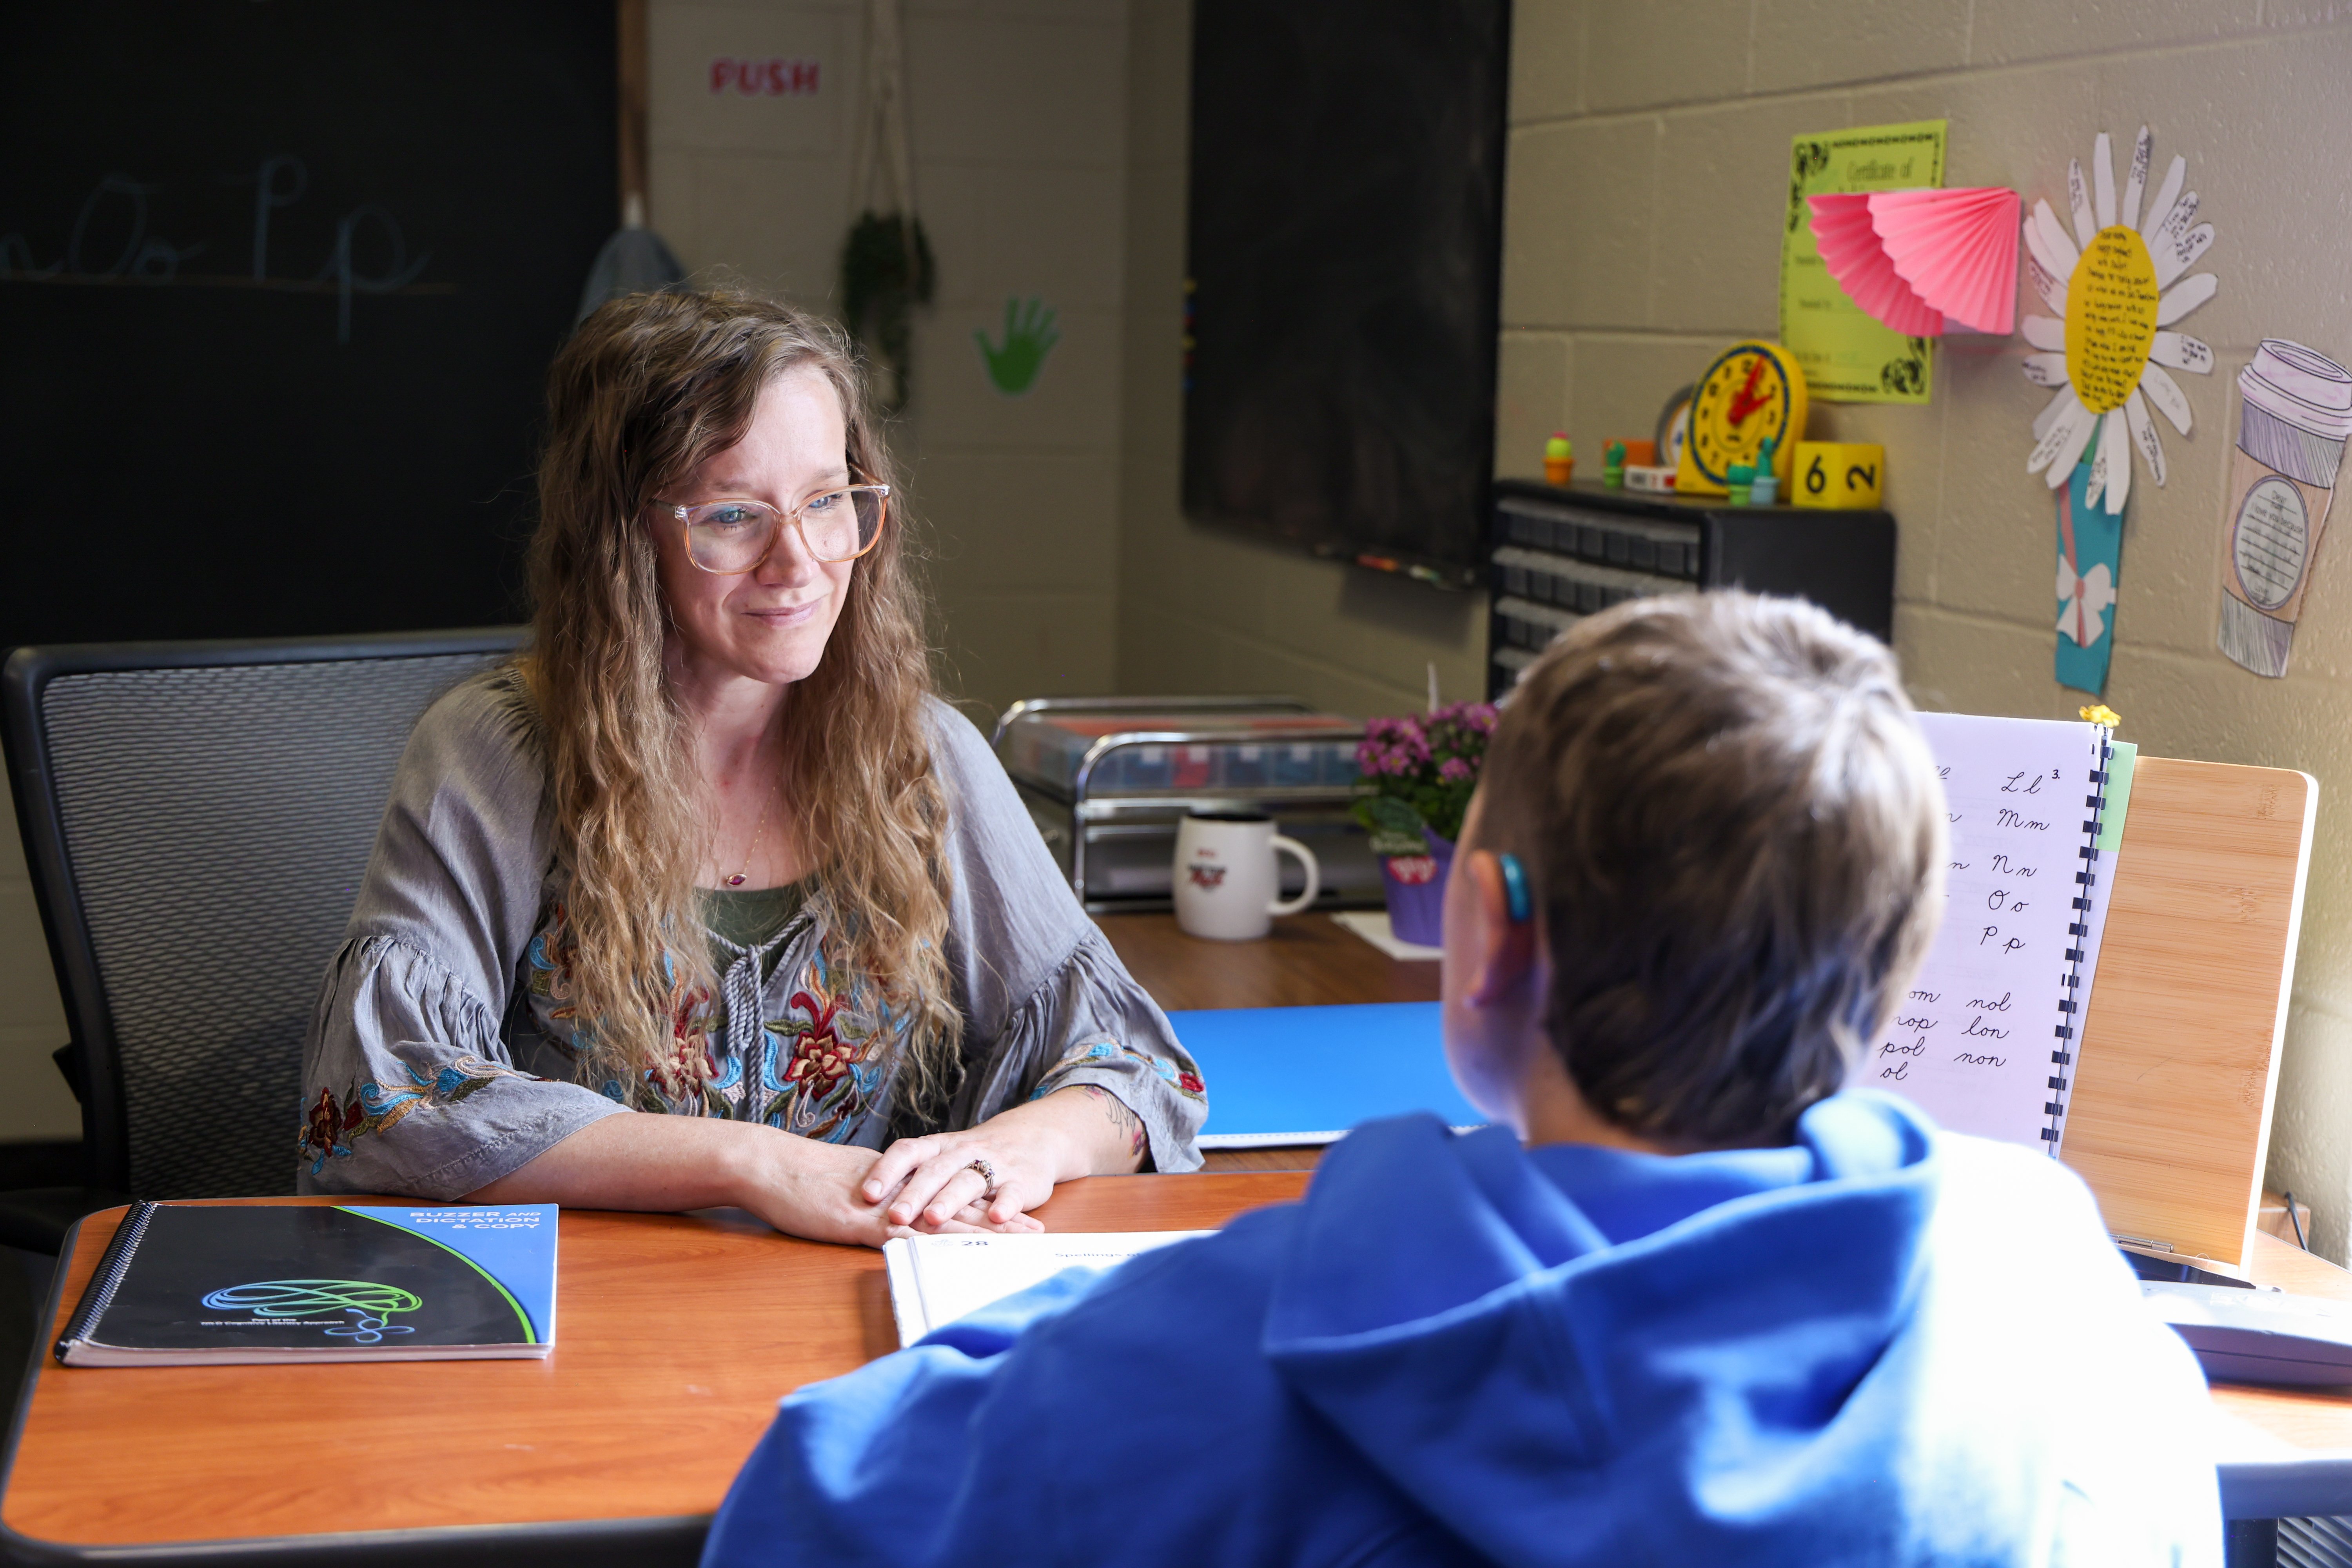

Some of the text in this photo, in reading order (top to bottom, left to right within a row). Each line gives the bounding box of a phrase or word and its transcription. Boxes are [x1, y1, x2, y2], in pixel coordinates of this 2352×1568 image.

[710, 59, 820, 95] PUSH
[1807, 455, 1826, 494] 6
[1847, 465, 1875, 490] 2
[1965, 992, 2011, 1011] nol
[1961, 1016, 2009, 1039] lon
[1877, 1036, 2006, 1067] pol non
